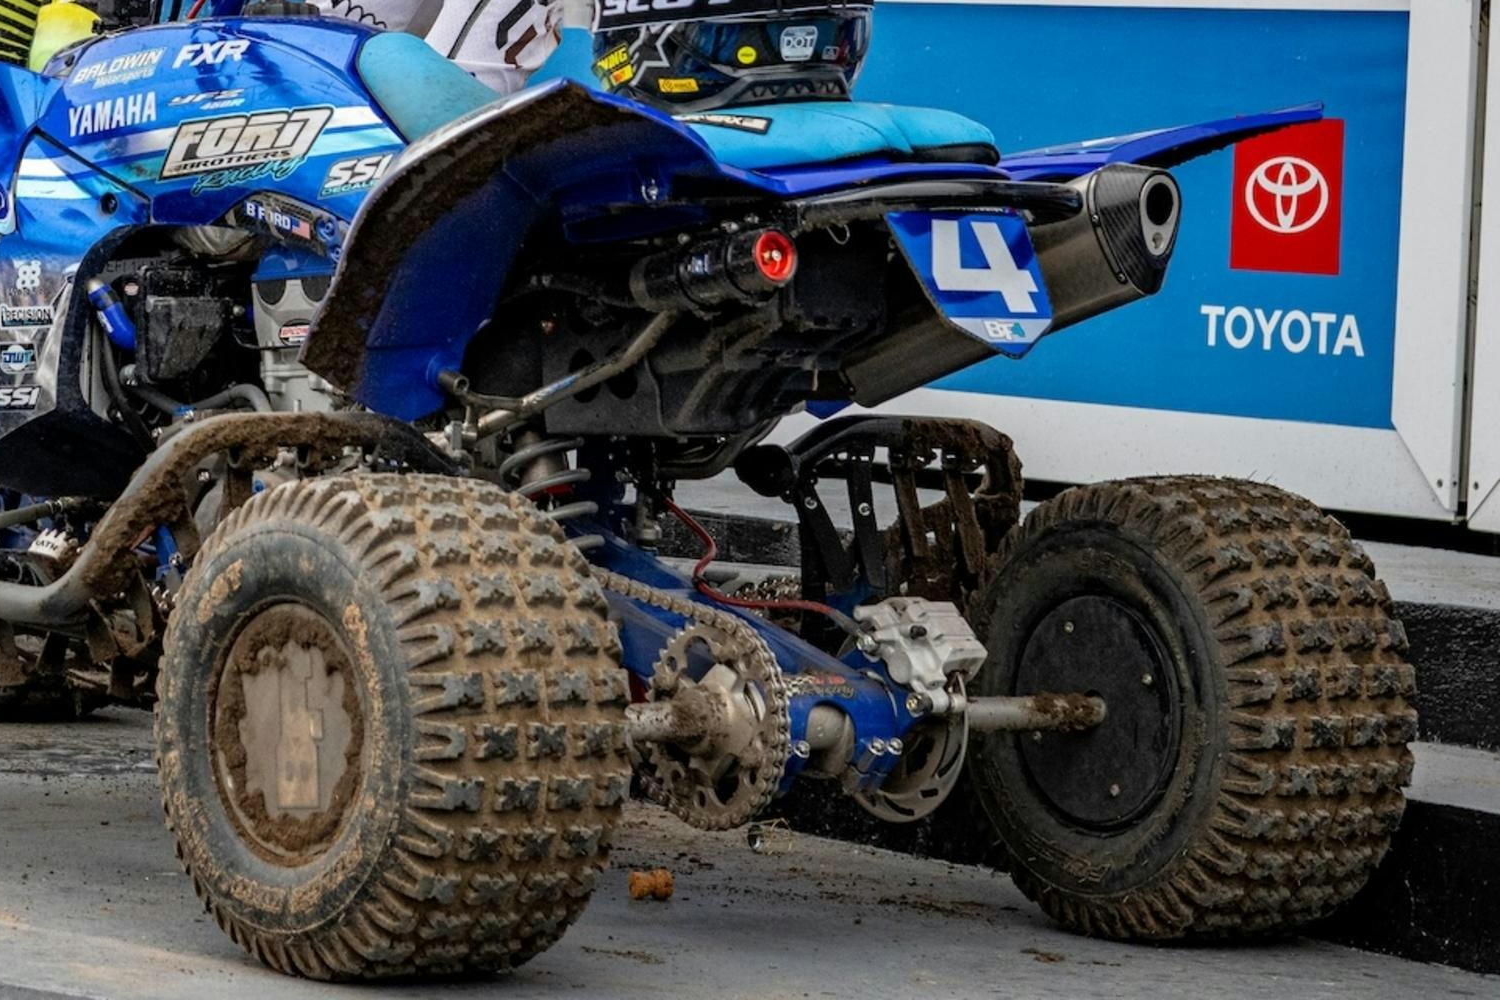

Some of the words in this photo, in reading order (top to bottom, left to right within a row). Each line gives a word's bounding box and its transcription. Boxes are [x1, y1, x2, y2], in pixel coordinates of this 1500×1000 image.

[172, 39, 251, 70] FXR
[783, 36, 813, 49] DOT
[72, 47, 167, 87] BALDWIN
[68, 91, 157, 138] YAMAHA
[164, 106, 334, 172] FORD
[180, 149, 292, 171] BROTHERS
[325, 153, 393, 189] SSI
[321, 178, 380, 196] DECAL
[245, 200, 257, 218] B
[931, 219, 1039, 313] 4
[1201, 305, 1365, 357] TOYOTA
